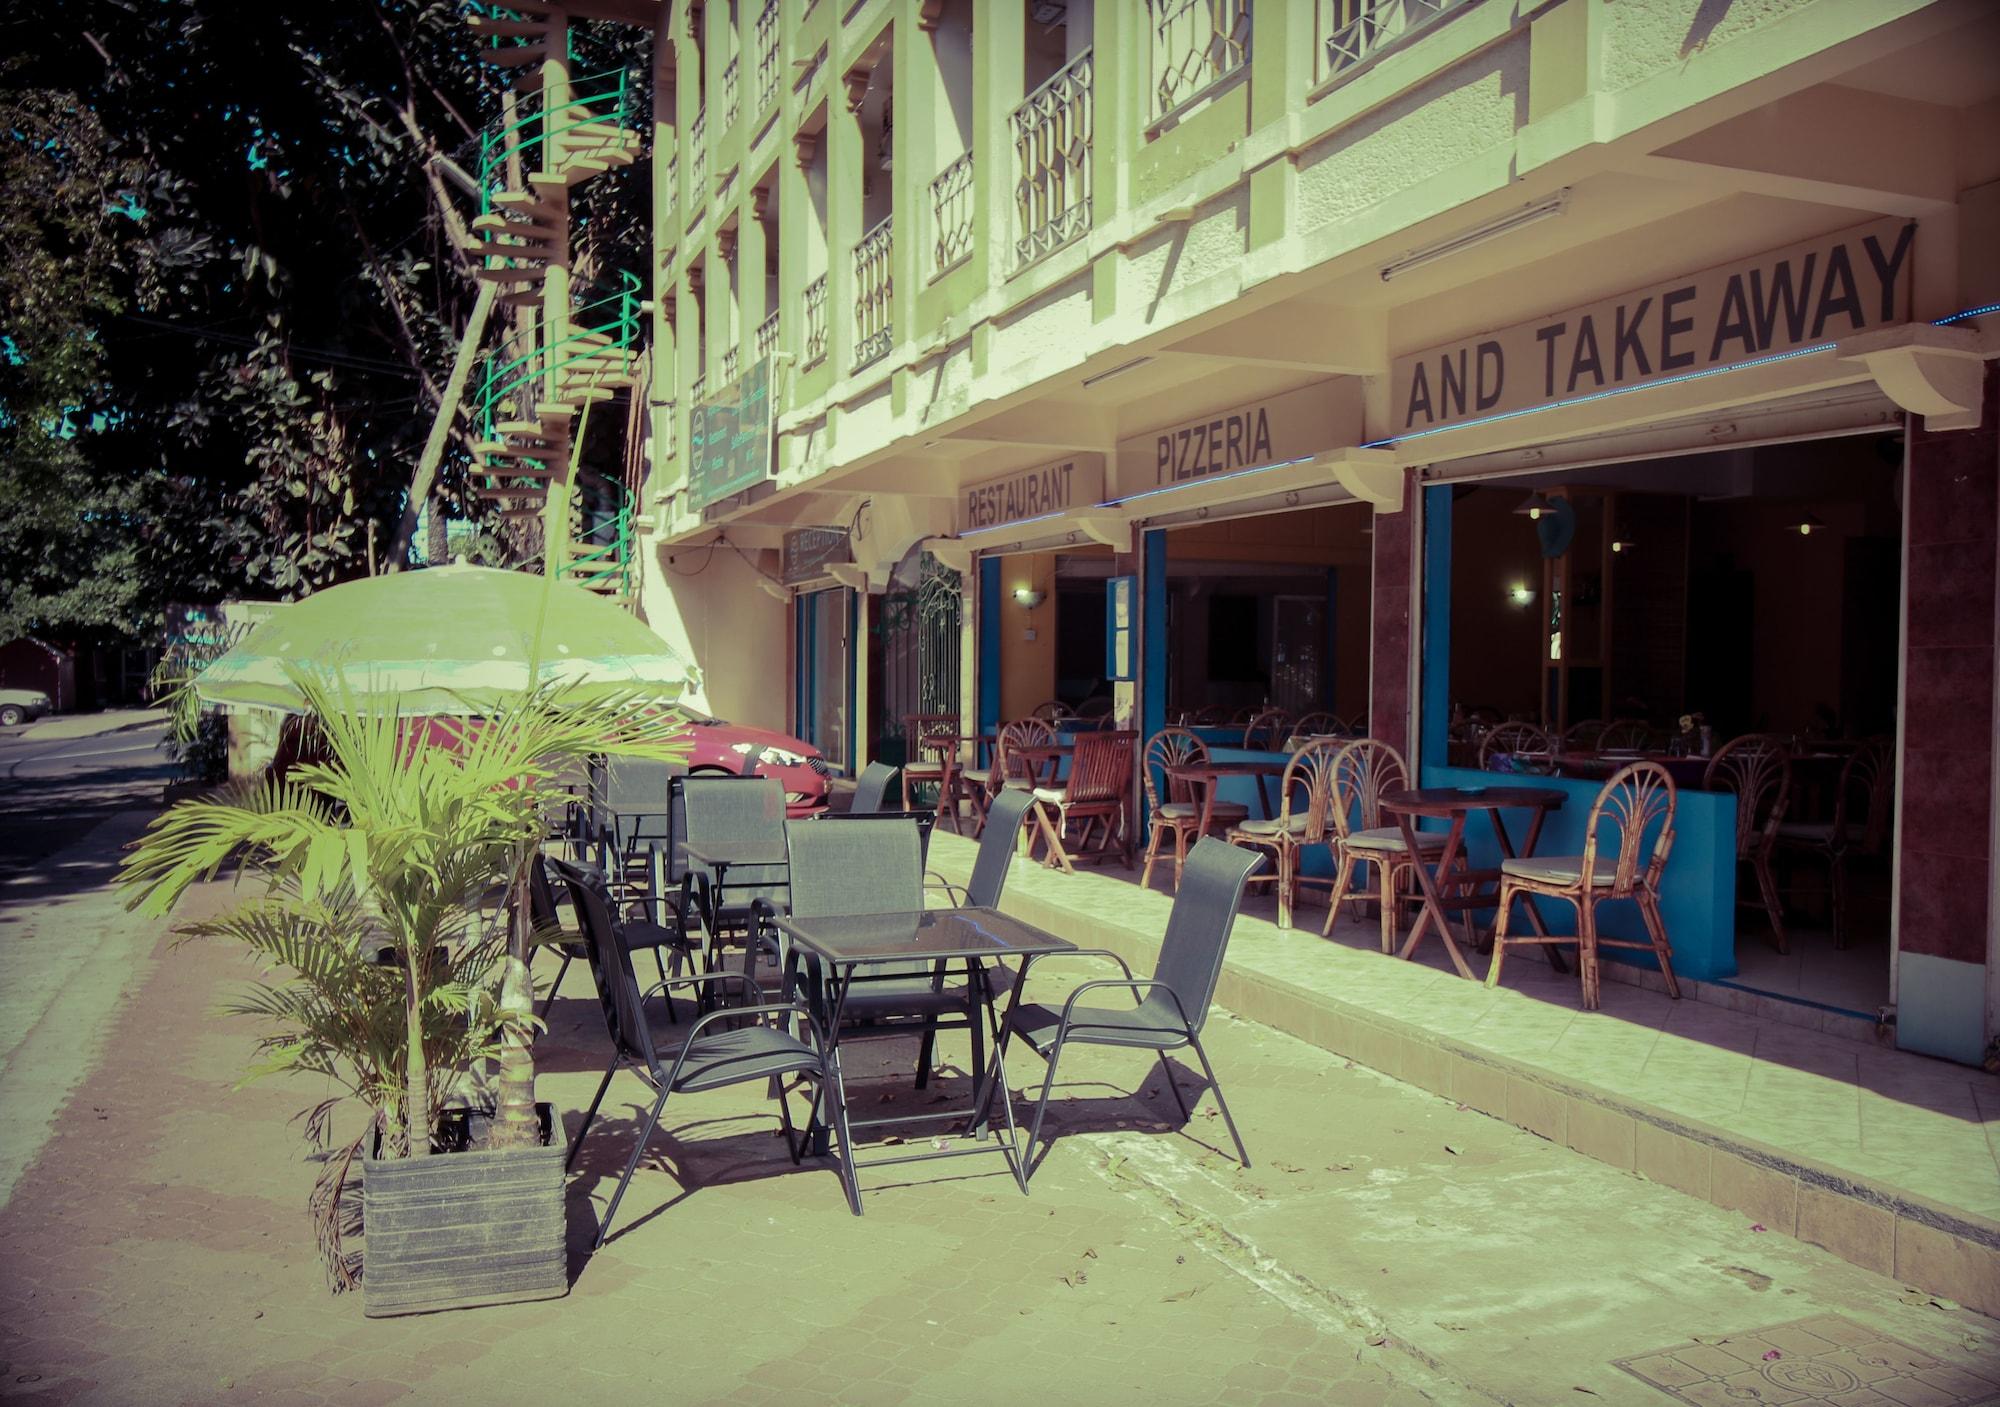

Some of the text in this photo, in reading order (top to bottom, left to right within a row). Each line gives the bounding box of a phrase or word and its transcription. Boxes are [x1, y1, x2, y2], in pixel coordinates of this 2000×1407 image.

[1405, 340, 1504, 429] AND
[1157, 407, 1273, 485] PIZZERIA
[968, 463, 1073, 529] RESTAURANT
